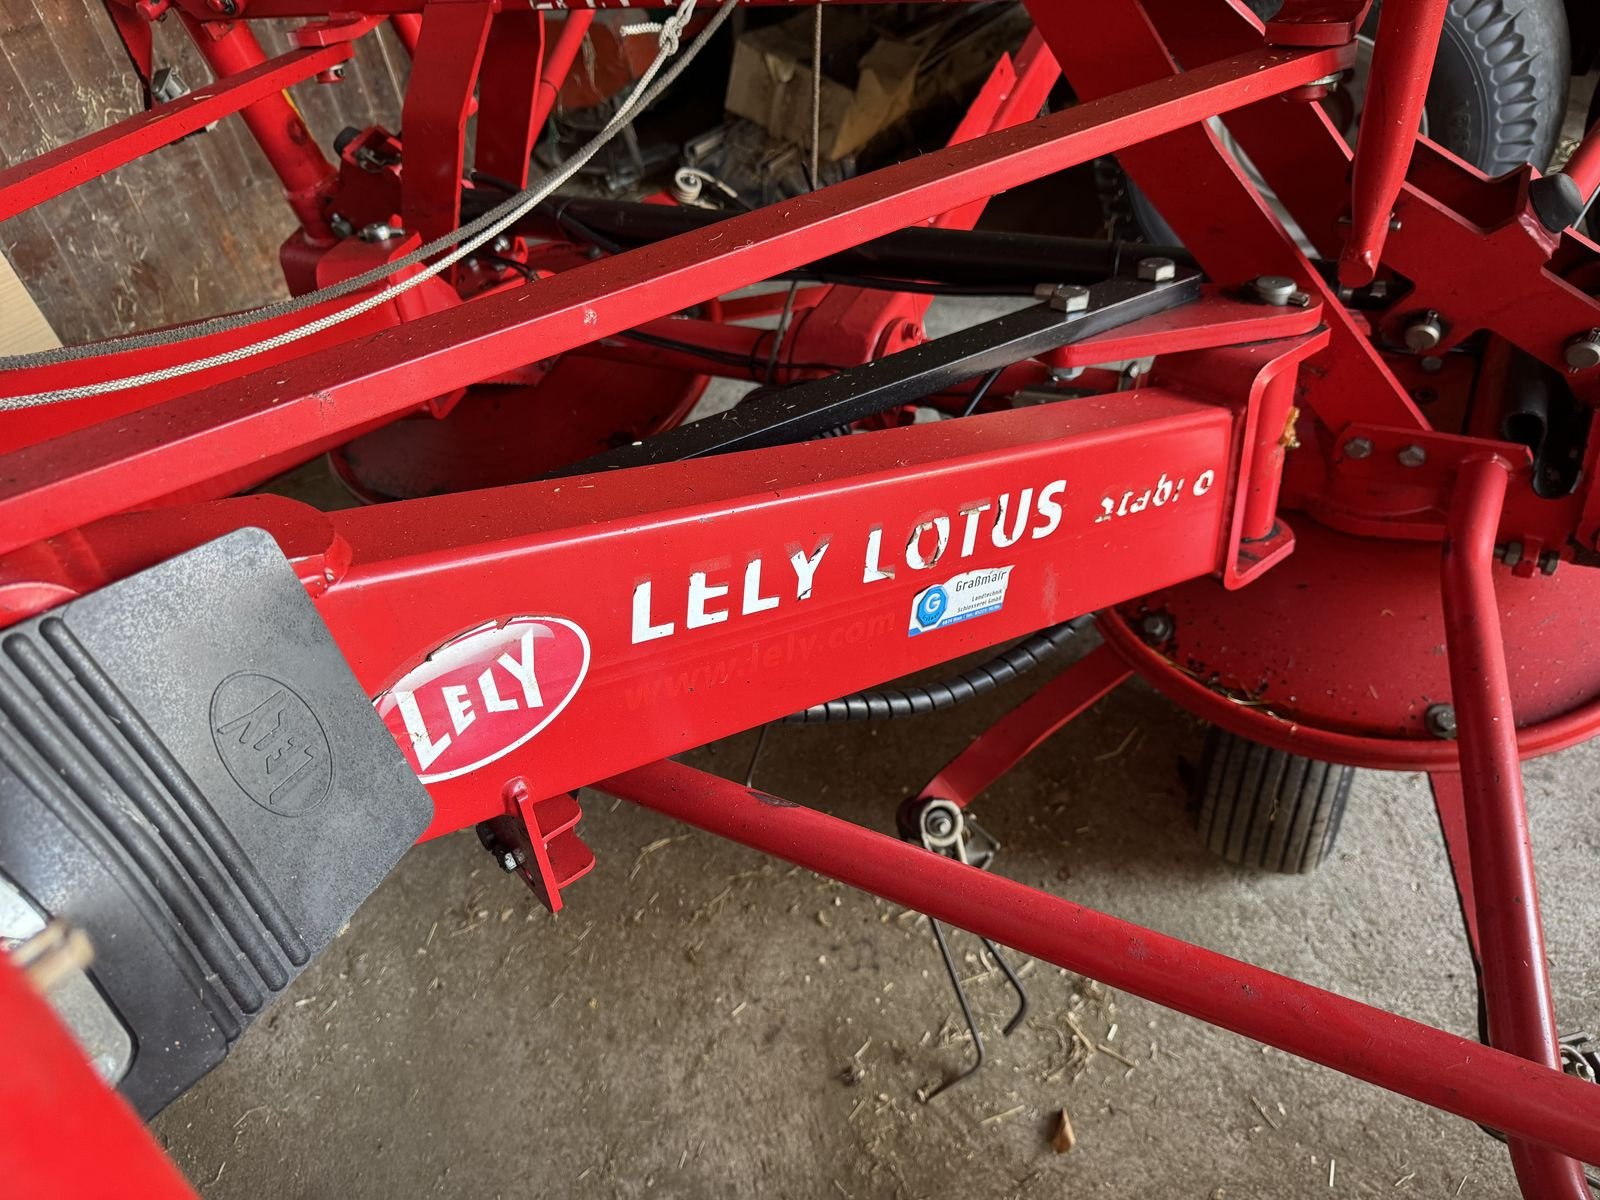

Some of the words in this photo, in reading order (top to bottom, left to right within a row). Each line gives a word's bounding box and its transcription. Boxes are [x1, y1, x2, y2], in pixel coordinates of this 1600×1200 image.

[631, 543, 831, 645] LELY
[863, 480, 1067, 584] LOTUS
[955, 570, 1008, 593] Graßmair
[395, 627, 544, 772] LELY
[624, 611, 896, 713] www.lely.com
